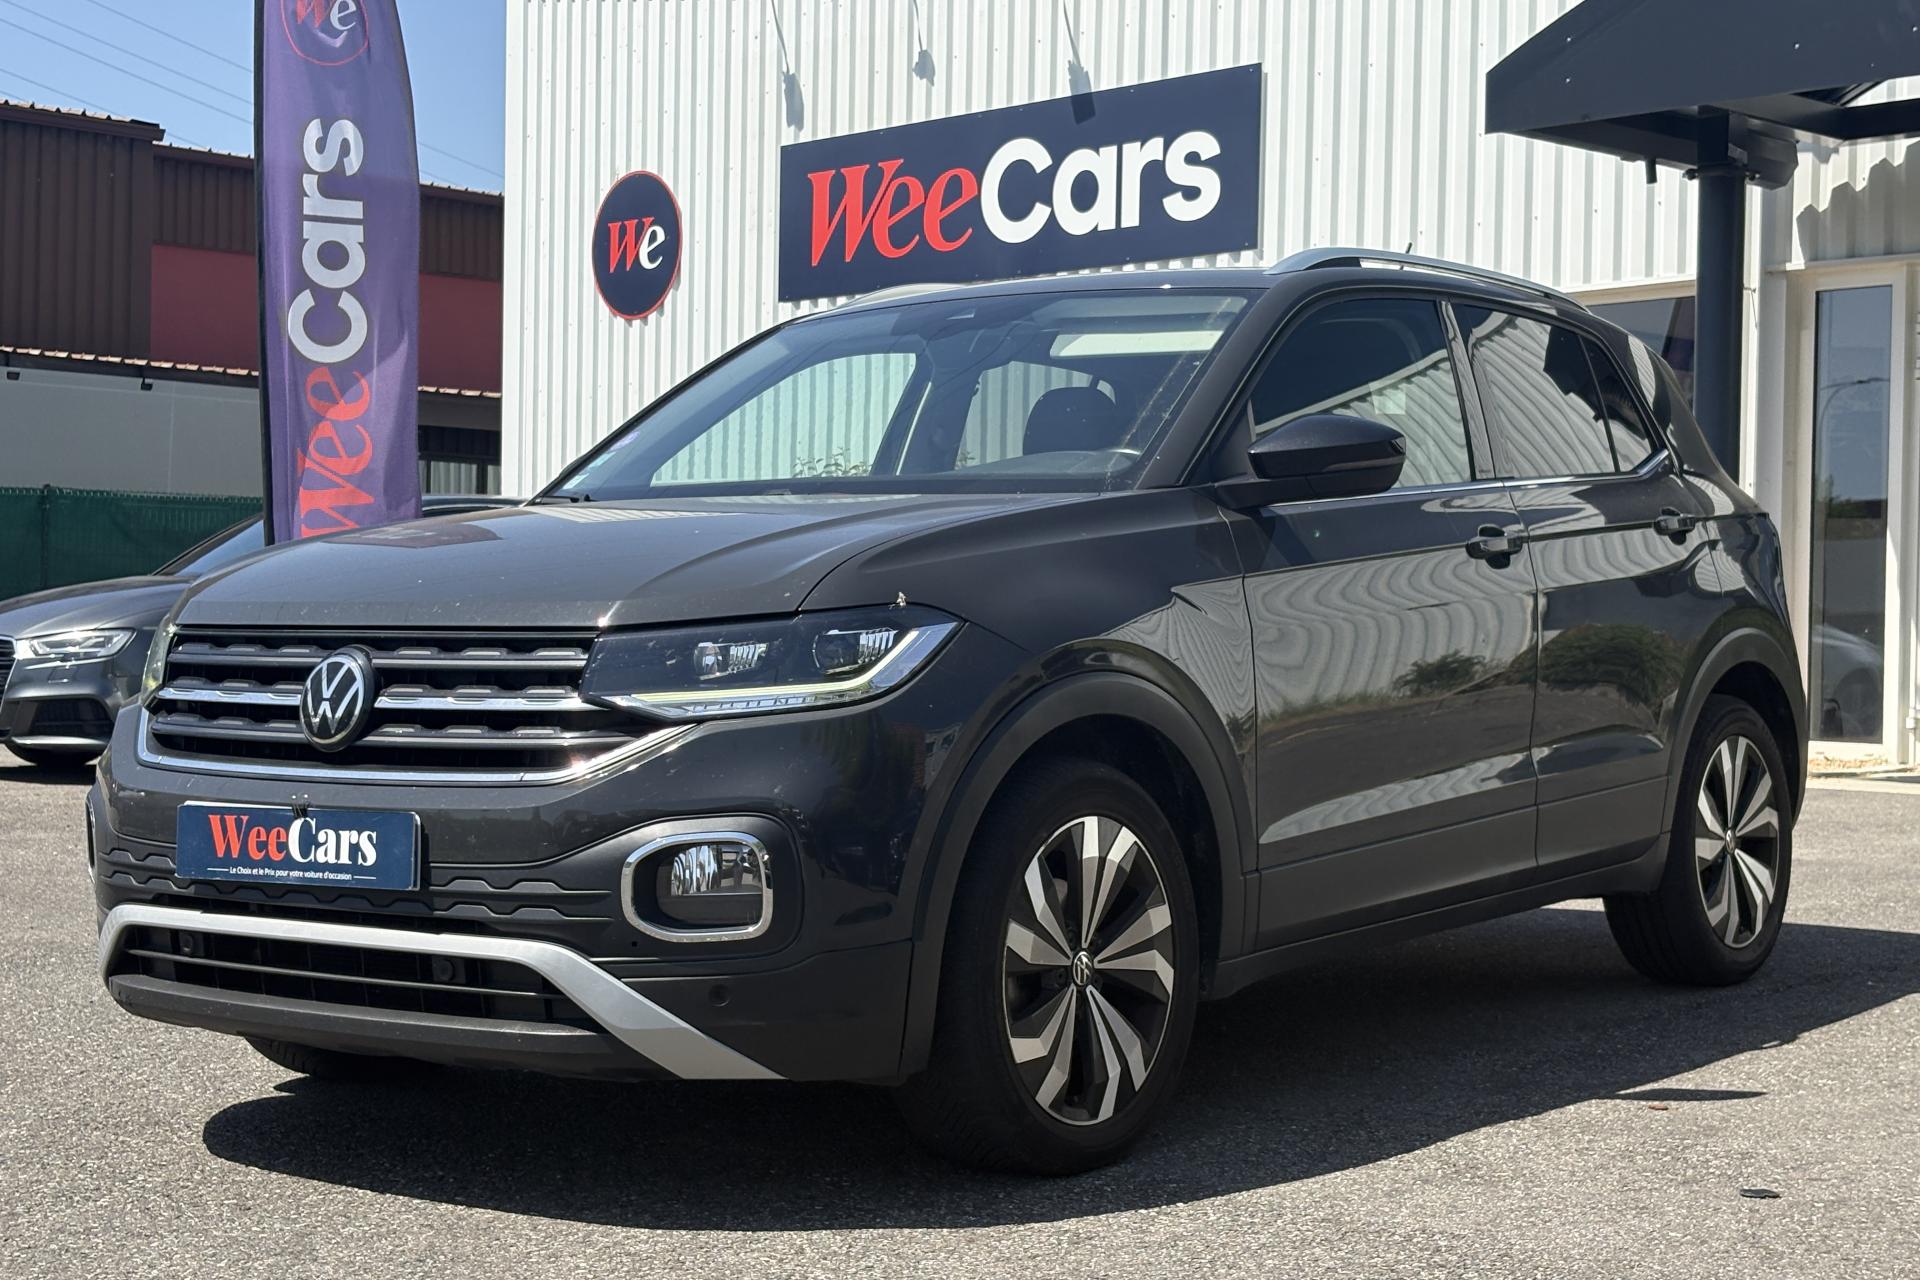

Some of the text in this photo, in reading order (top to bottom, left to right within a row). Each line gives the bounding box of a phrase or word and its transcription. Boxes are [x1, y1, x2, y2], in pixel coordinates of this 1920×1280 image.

[808, 131, 1221, 267] WeeCars
[608, 217, 665, 273] We
[208, 814, 377, 866] WeeCars
[265, 868, 275, 876] Prix
[275, 870, 288, 878] pour
[323, 871, 352, 880] d'occasion
